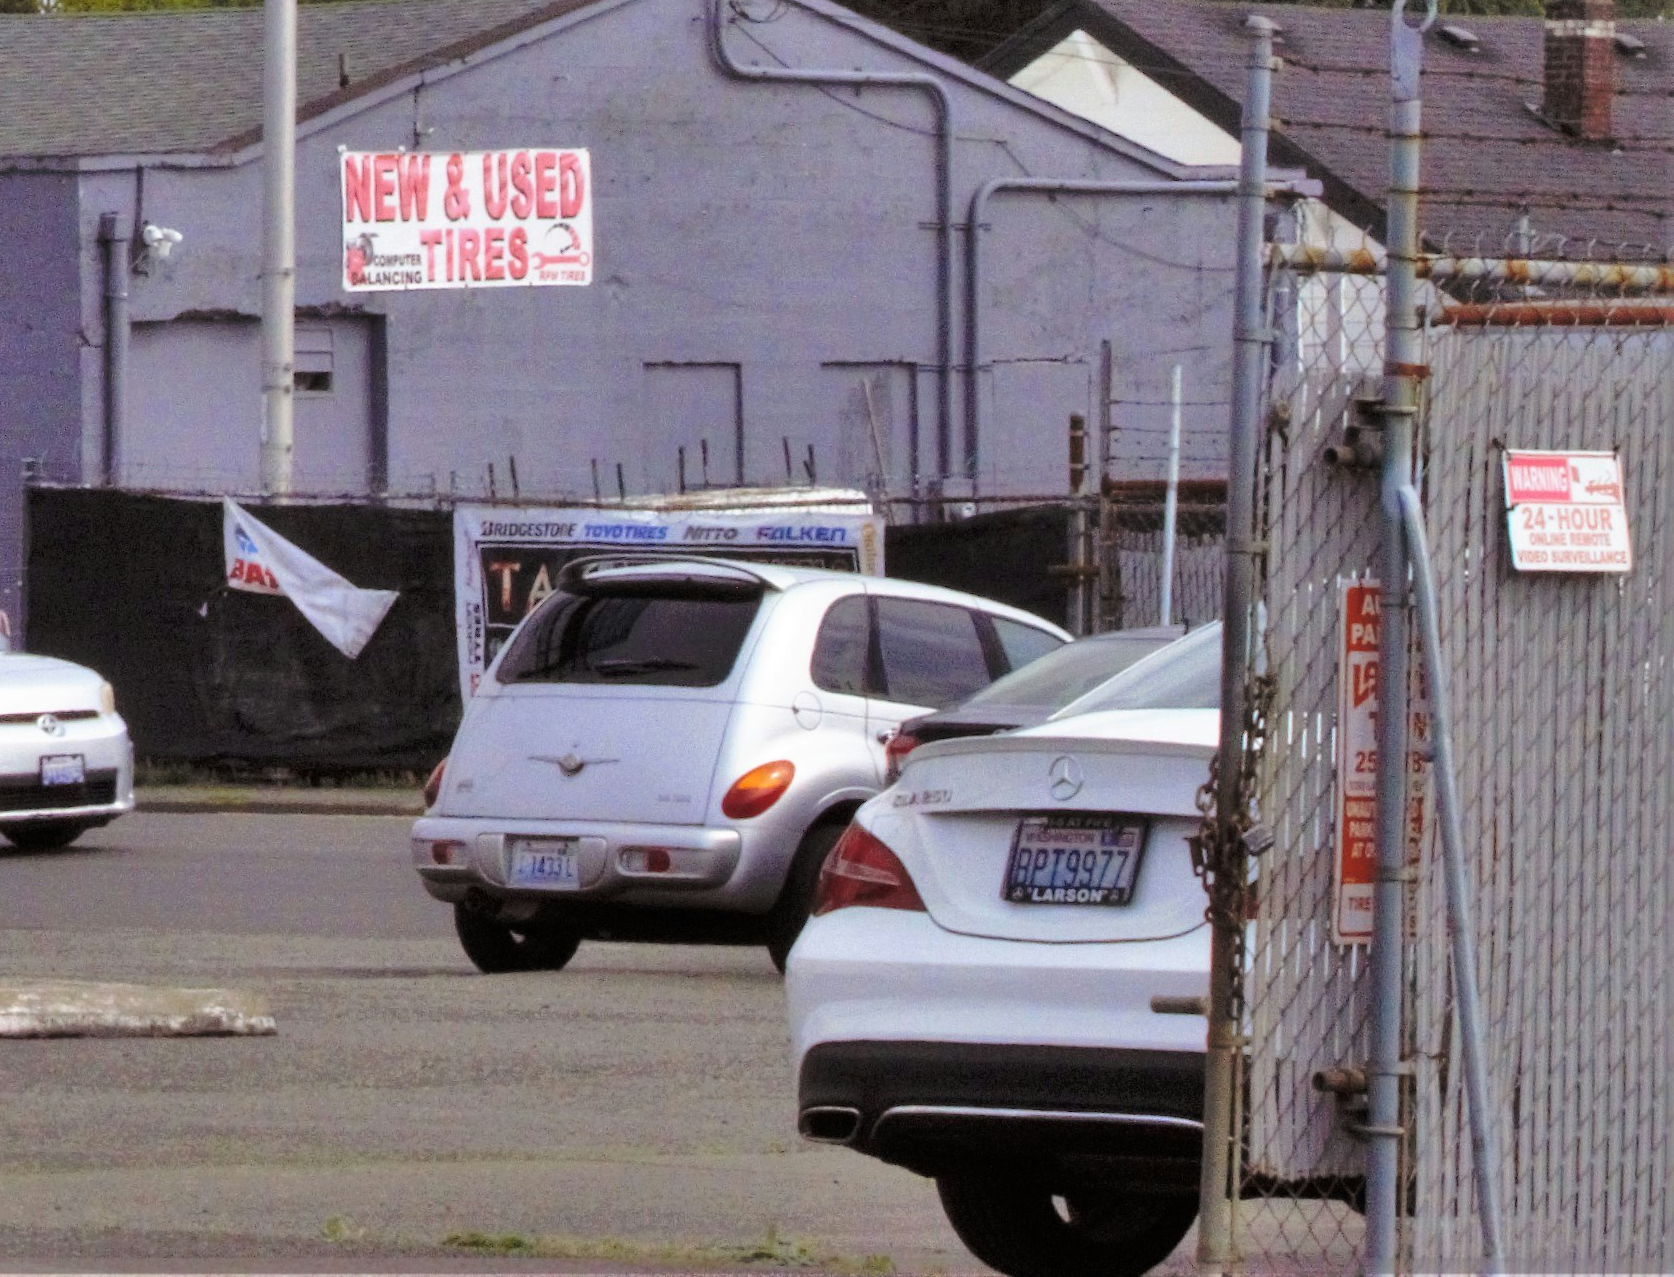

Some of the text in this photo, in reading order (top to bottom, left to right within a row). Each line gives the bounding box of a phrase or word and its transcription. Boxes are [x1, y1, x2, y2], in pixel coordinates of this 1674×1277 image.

[345, 151, 585, 223] NEW & USED
[420, 226, 529, 282] TIRES
[351, 270, 422, 286] BALANCING
[1511, 466, 1568, 493] WARNING
[683, 526, 738, 541] NITTO
[756, 526, 846, 542] FALKEN
[1529, 533, 1611, 546] ONLINE REMOTE
[1517, 550, 1627, 564] VIDEO SURVEILLANCE
